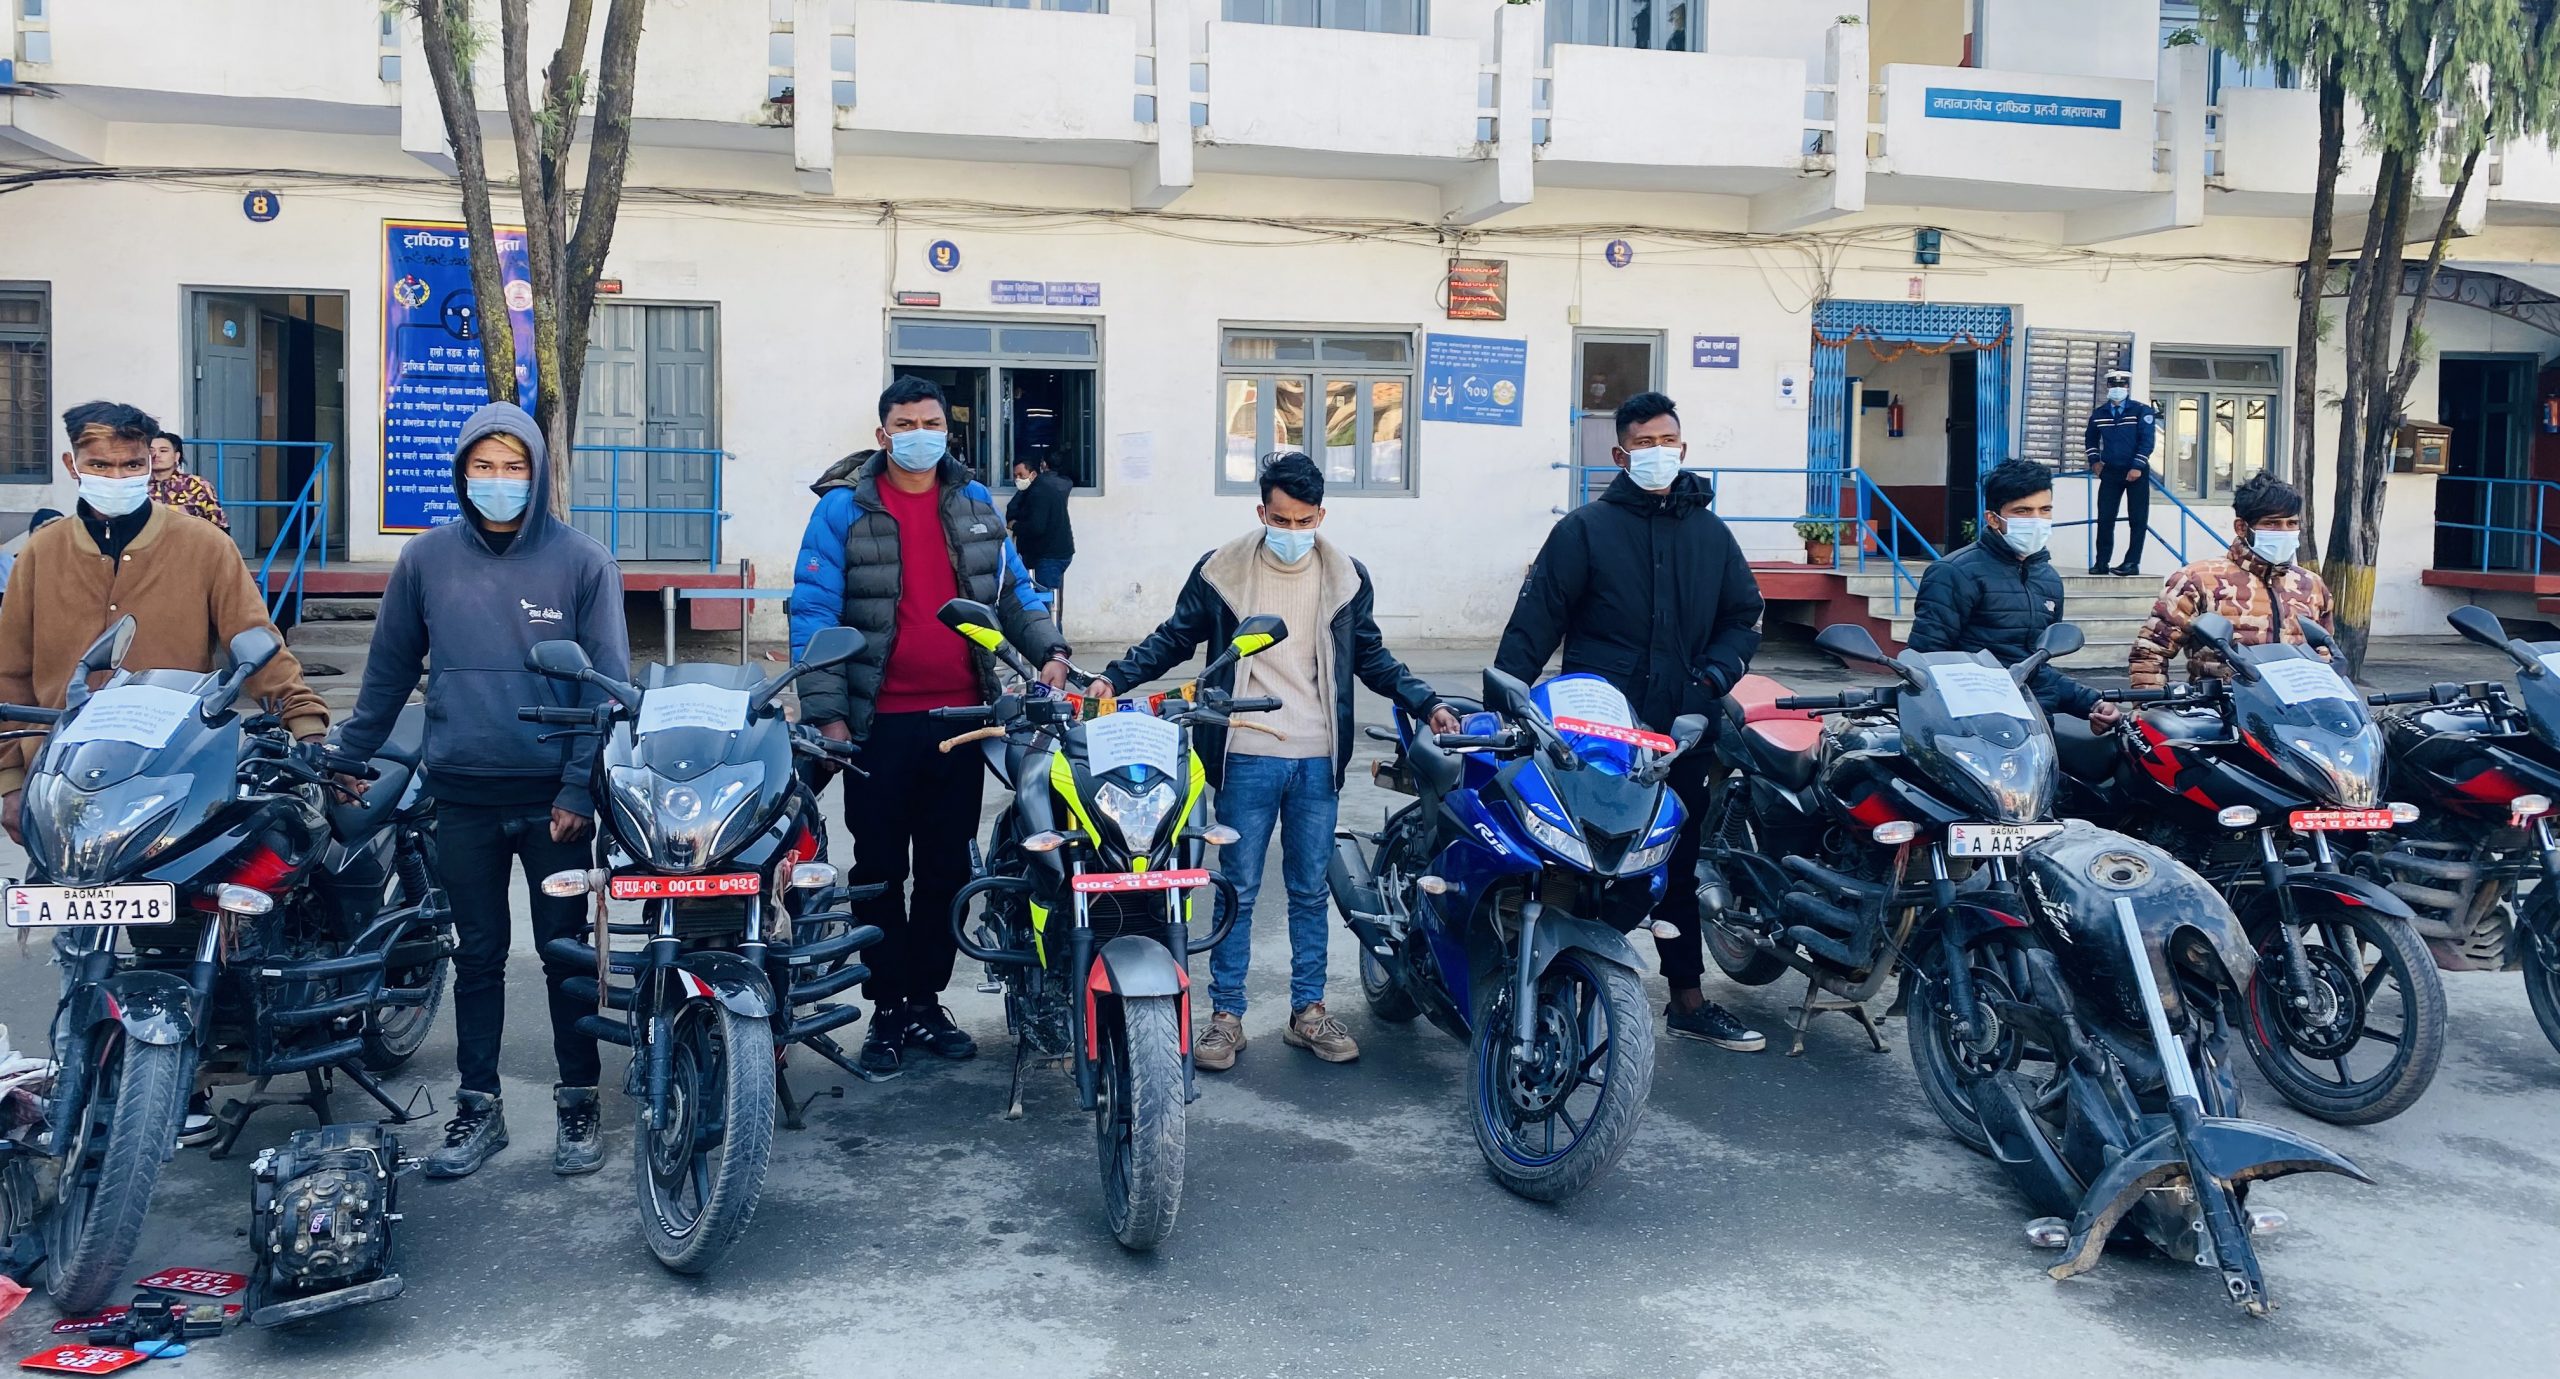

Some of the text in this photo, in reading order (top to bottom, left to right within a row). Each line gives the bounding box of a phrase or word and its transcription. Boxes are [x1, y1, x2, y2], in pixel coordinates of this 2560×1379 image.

[1933, 97, 2107, 119] महानगरीय ट्राफिक प्रहरी महाशाखा
[403, 232, 455, 248] ट्राफिक
[1991, 828, 2026, 836] BAGMATI
[64, 890, 114, 899] BAGMATI
[39, 899, 161, 921] A AA3718
